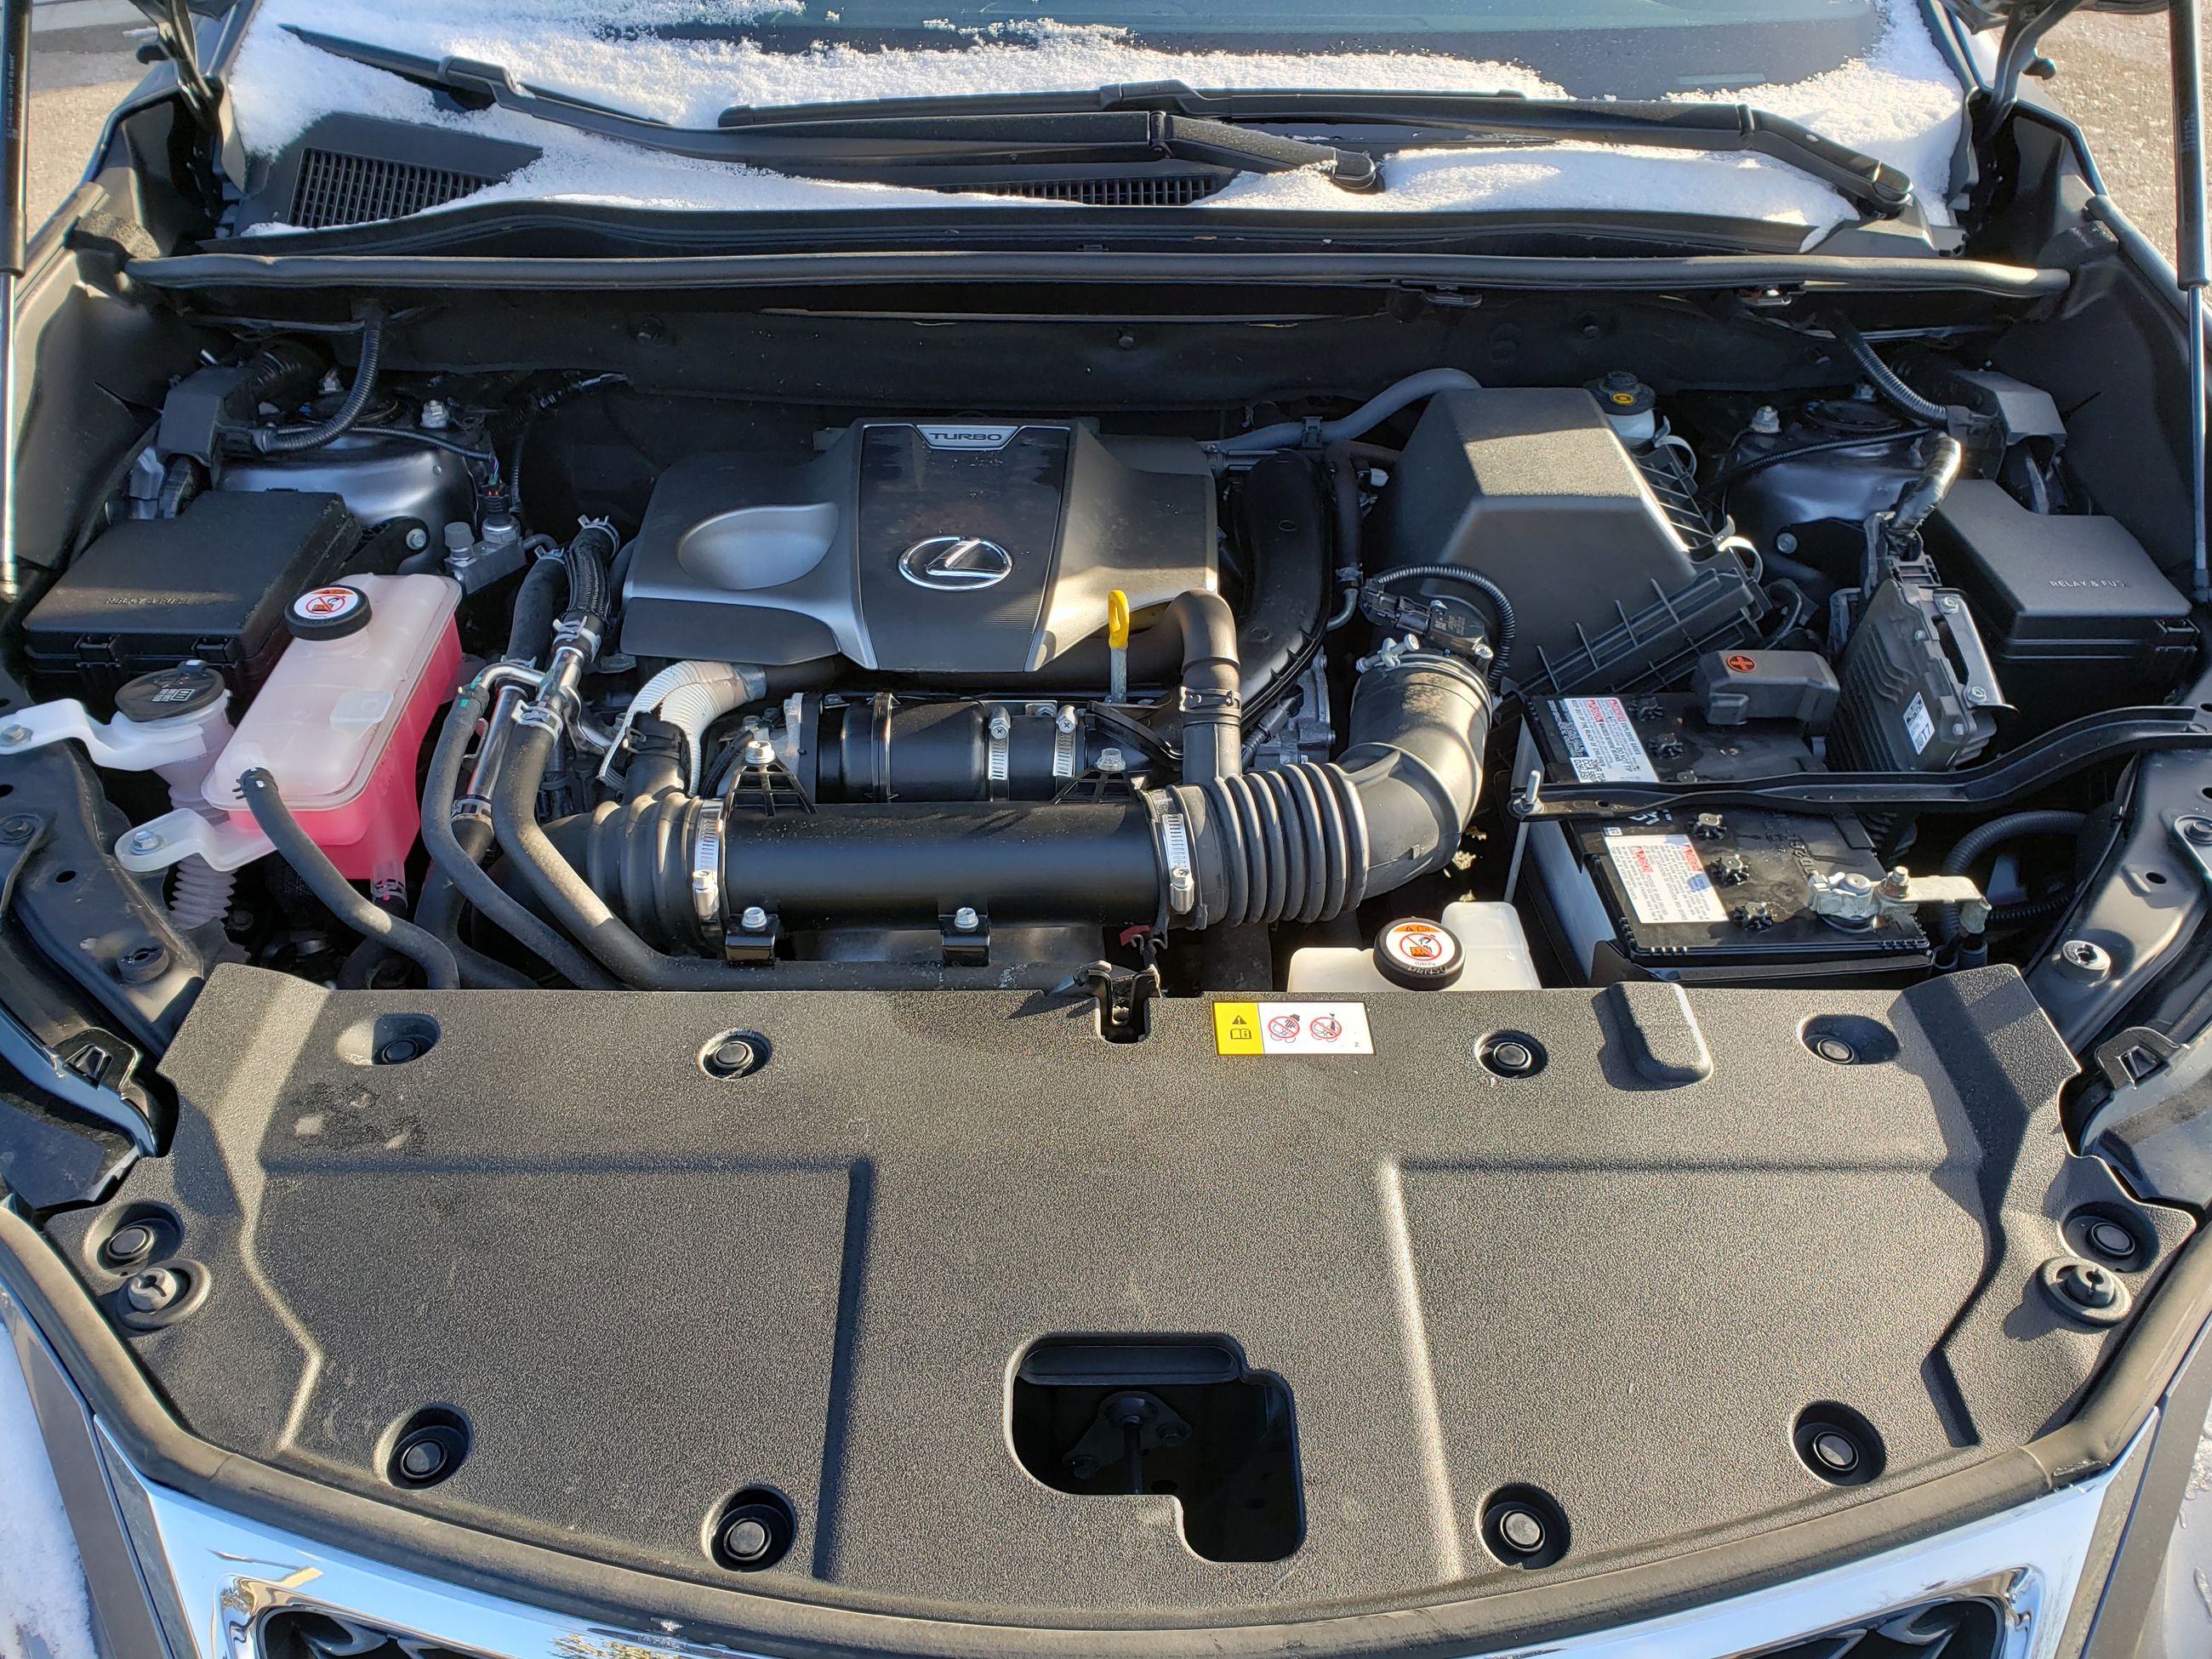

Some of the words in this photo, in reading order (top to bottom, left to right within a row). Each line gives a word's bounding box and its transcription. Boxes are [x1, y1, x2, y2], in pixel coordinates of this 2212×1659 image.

[929, 432, 1002, 442] TURBO
[105, 596, 149, 605] RELAY
[1582, 760, 1593, 770] CCA
[1406, 965, 1448, 975] DENSO
